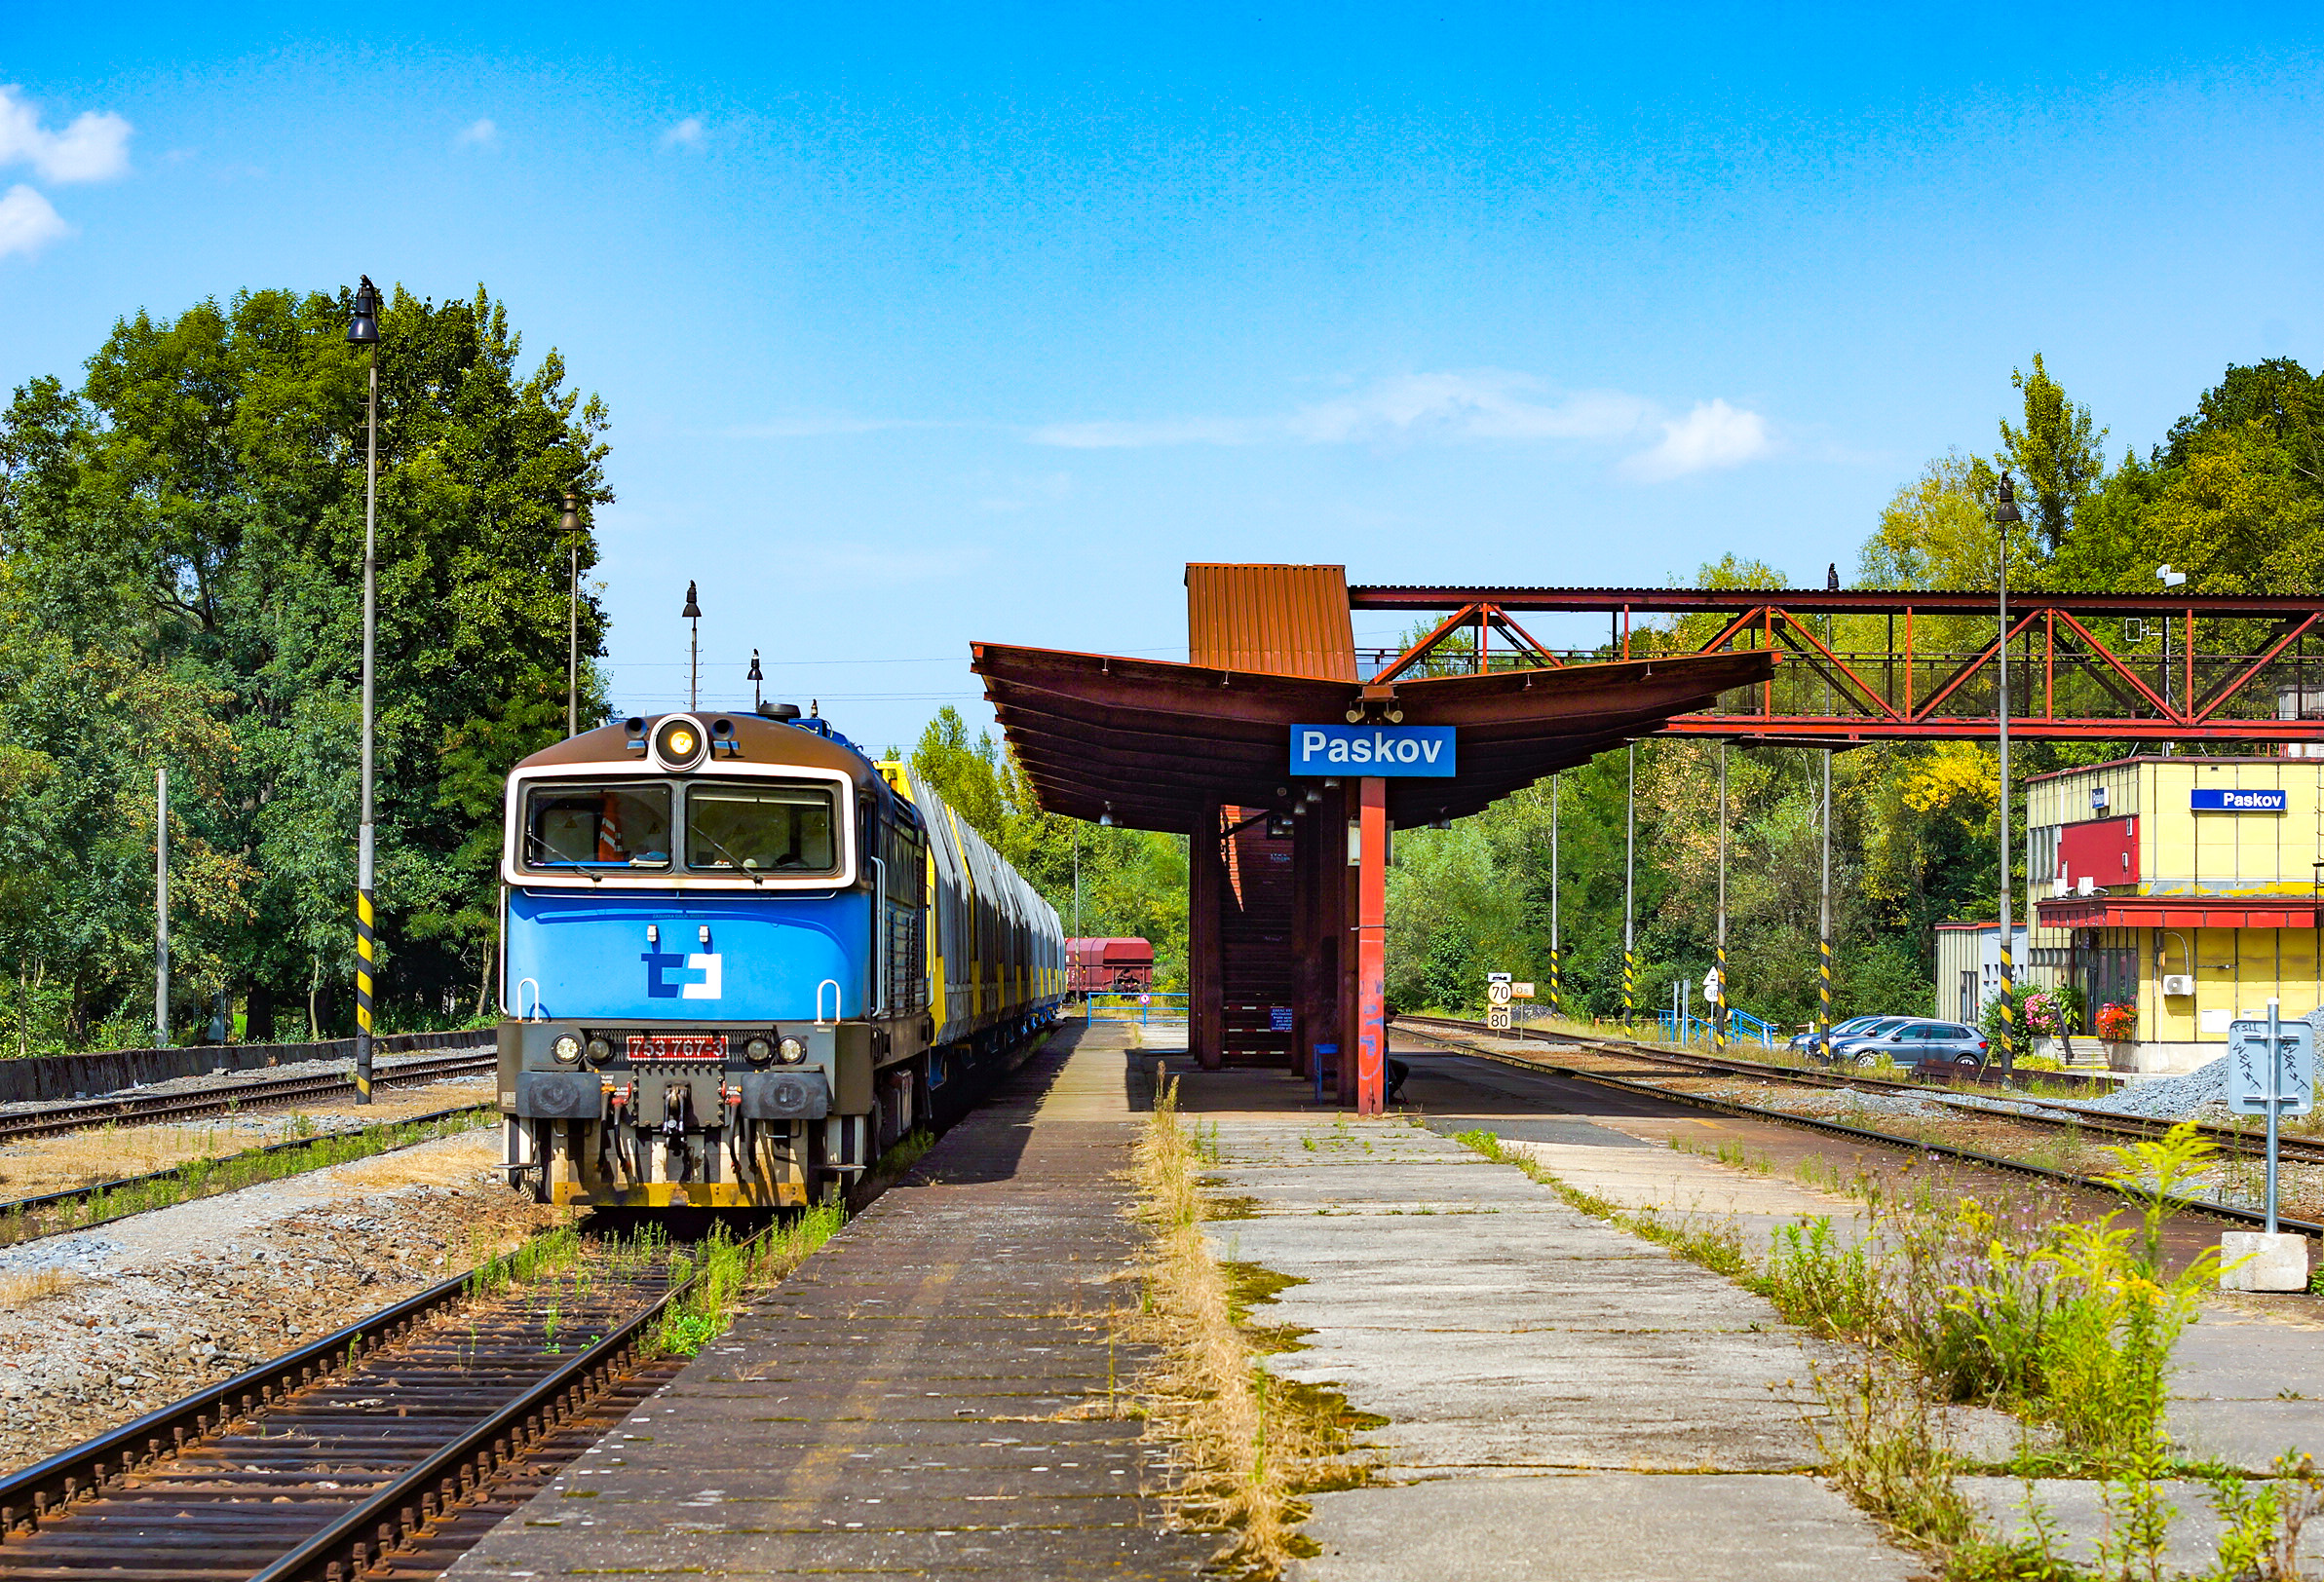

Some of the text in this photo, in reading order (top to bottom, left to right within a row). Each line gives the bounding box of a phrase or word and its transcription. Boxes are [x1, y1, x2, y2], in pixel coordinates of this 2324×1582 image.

[1302, 731, 1442, 764] Paskov
[2223, 792, 2282, 808] Paskov
[1492, 986, 1508, 999] 70
[1516, 986, 1529, 995] Os
[1491, 1013, 1508, 1028] 80
[631, 1039, 724, 1057] 753 767-3
